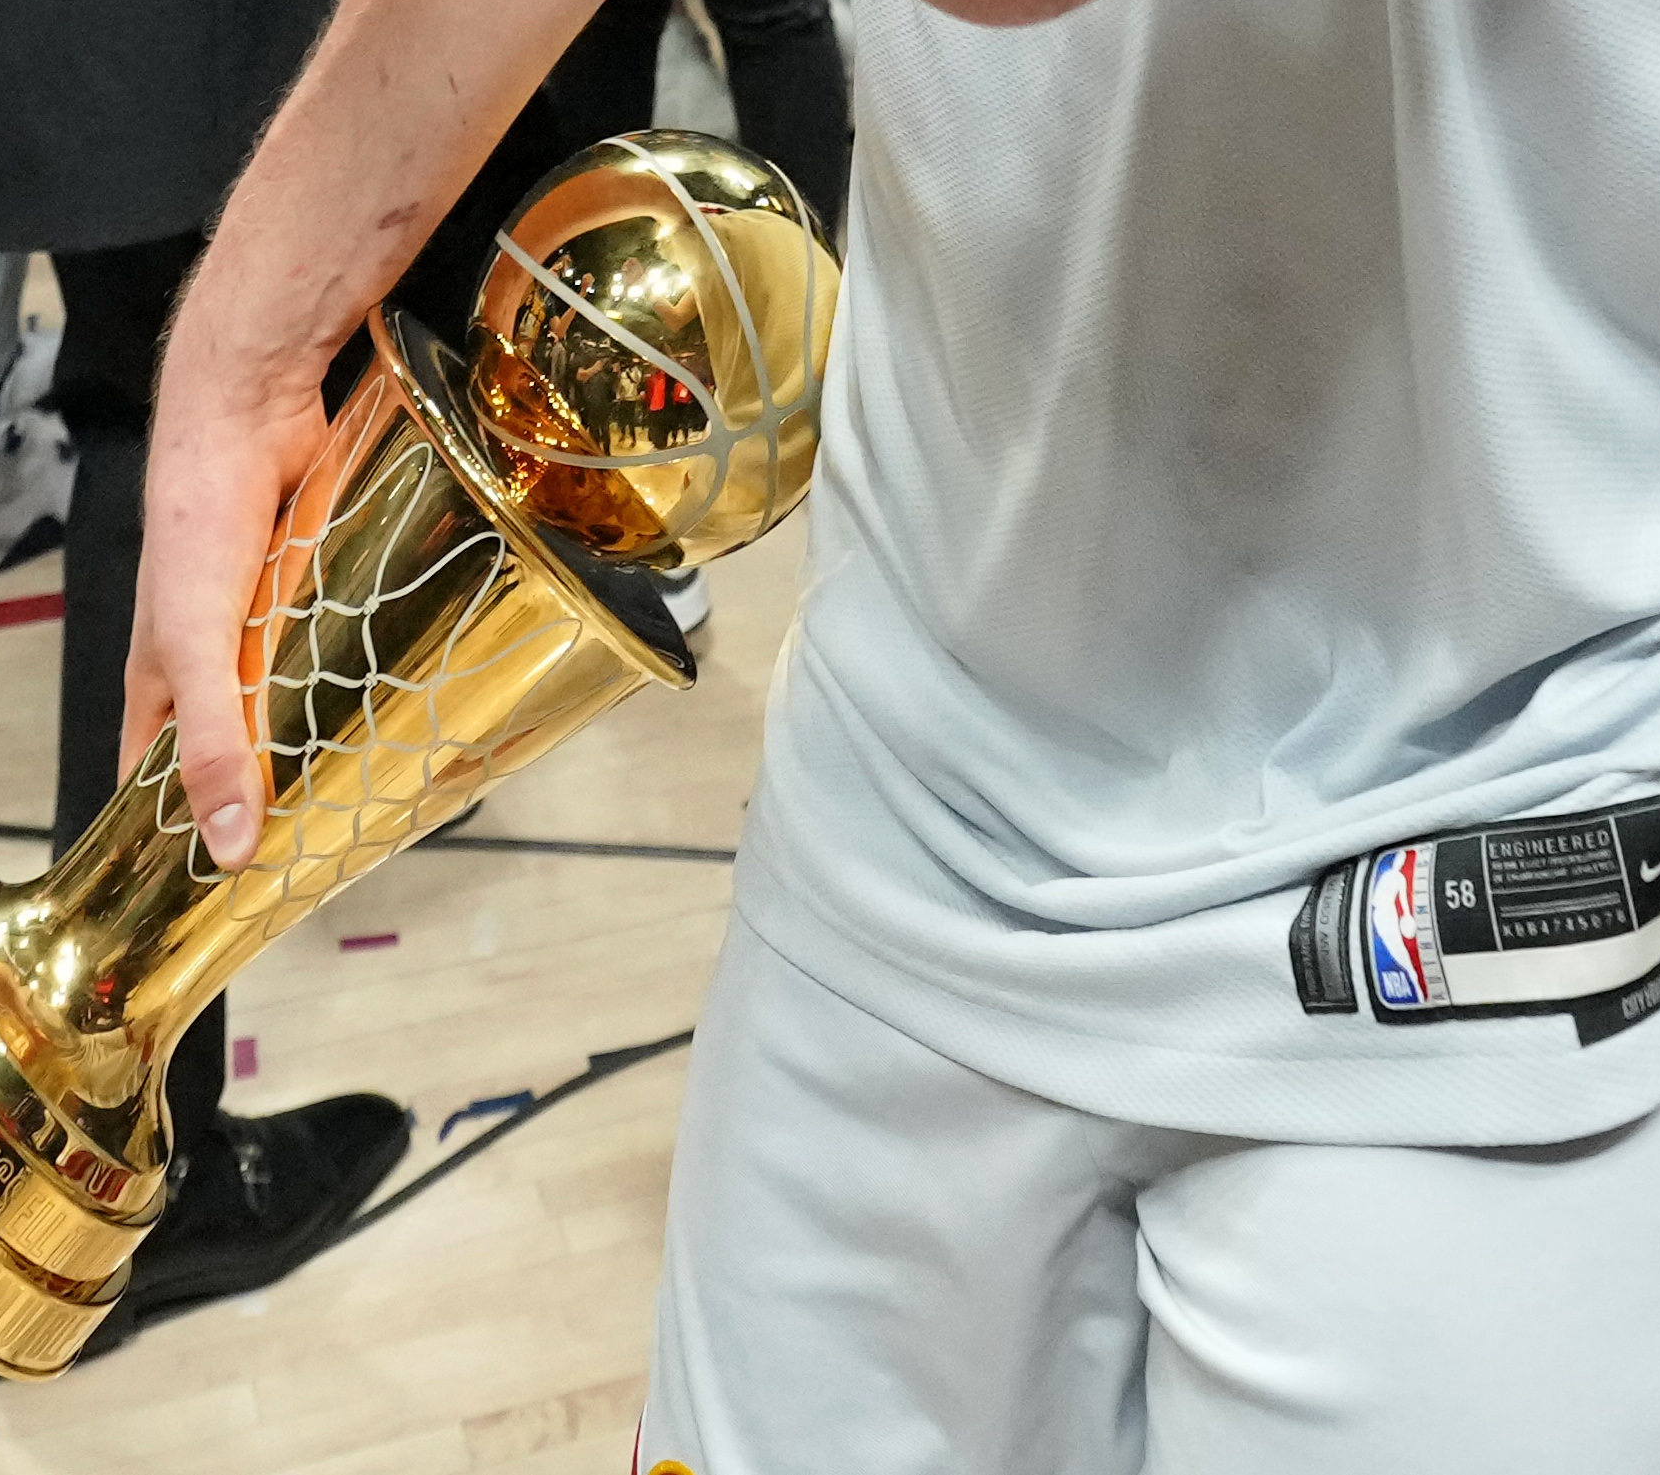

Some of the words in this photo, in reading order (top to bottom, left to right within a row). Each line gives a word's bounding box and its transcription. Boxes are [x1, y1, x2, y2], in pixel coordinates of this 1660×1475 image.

[1488, 829, 1612, 860] ENGINEERED
[1444, 878, 1477, 910] 58
[1383, 969, 1413, 999] NBA
